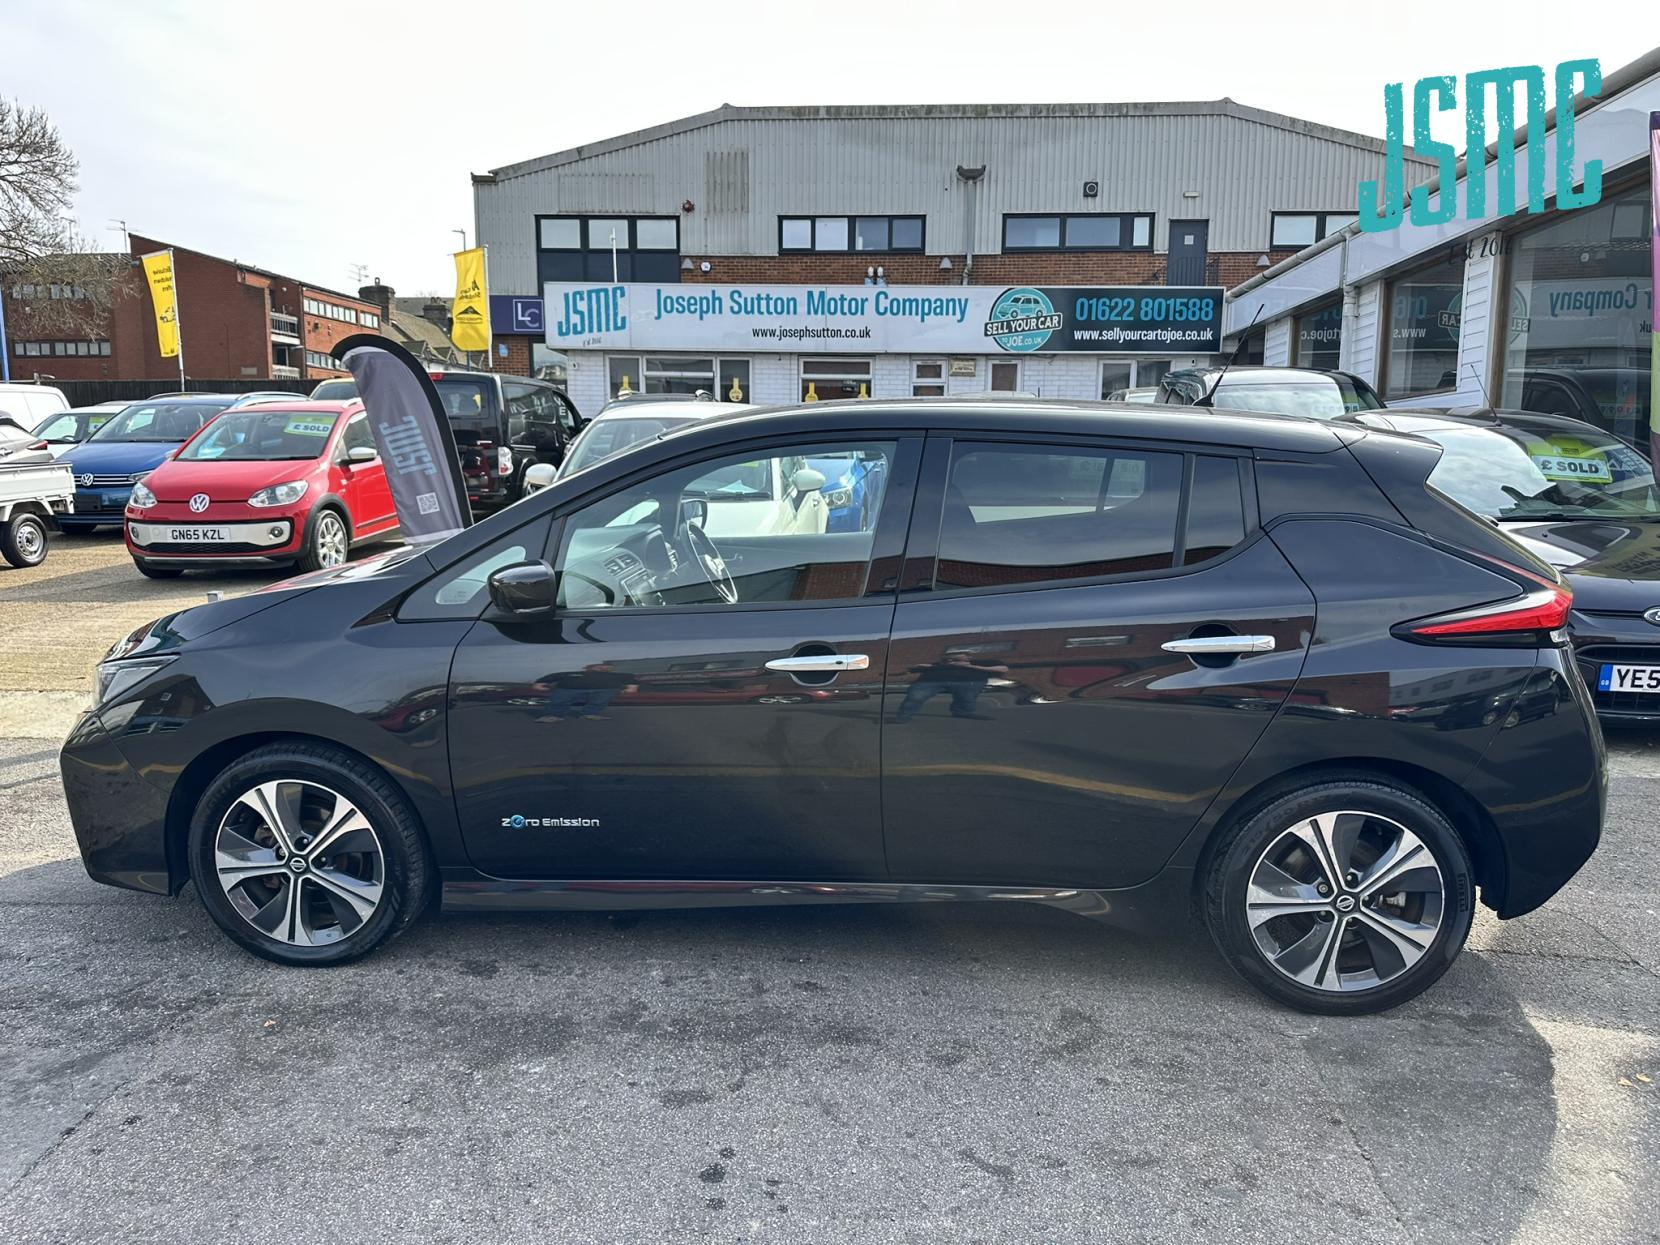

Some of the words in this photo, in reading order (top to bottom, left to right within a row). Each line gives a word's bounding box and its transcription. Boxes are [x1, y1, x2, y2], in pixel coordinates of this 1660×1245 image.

[557, 286, 627, 337] JSMC
[654, 289, 723, 320] Joseph
[729, 289, 798, 315] Sutton
[806, 290, 869, 316] Motor
[874, 290, 969, 323] Company
[1075, 298, 1135, 321] 01622
[1140, 298, 1214, 321] 801588
[752, 325, 871, 341] www.josephsutton.co.uk
[986, 321, 1009, 335] SELL
[1010, 318, 1037, 332] YOUR
[1038, 315, 1060, 329] CAR
[1073, 327, 1214, 344] www.sellyourcartojoe.co.uk
[1541, 460, 1552, 470] £
[1556, 461, 1600, 474] SOLD
[171, 529, 200, 540] GN65
[202, 529, 225, 540] KZL
[542, 817, 600, 827] Emission
